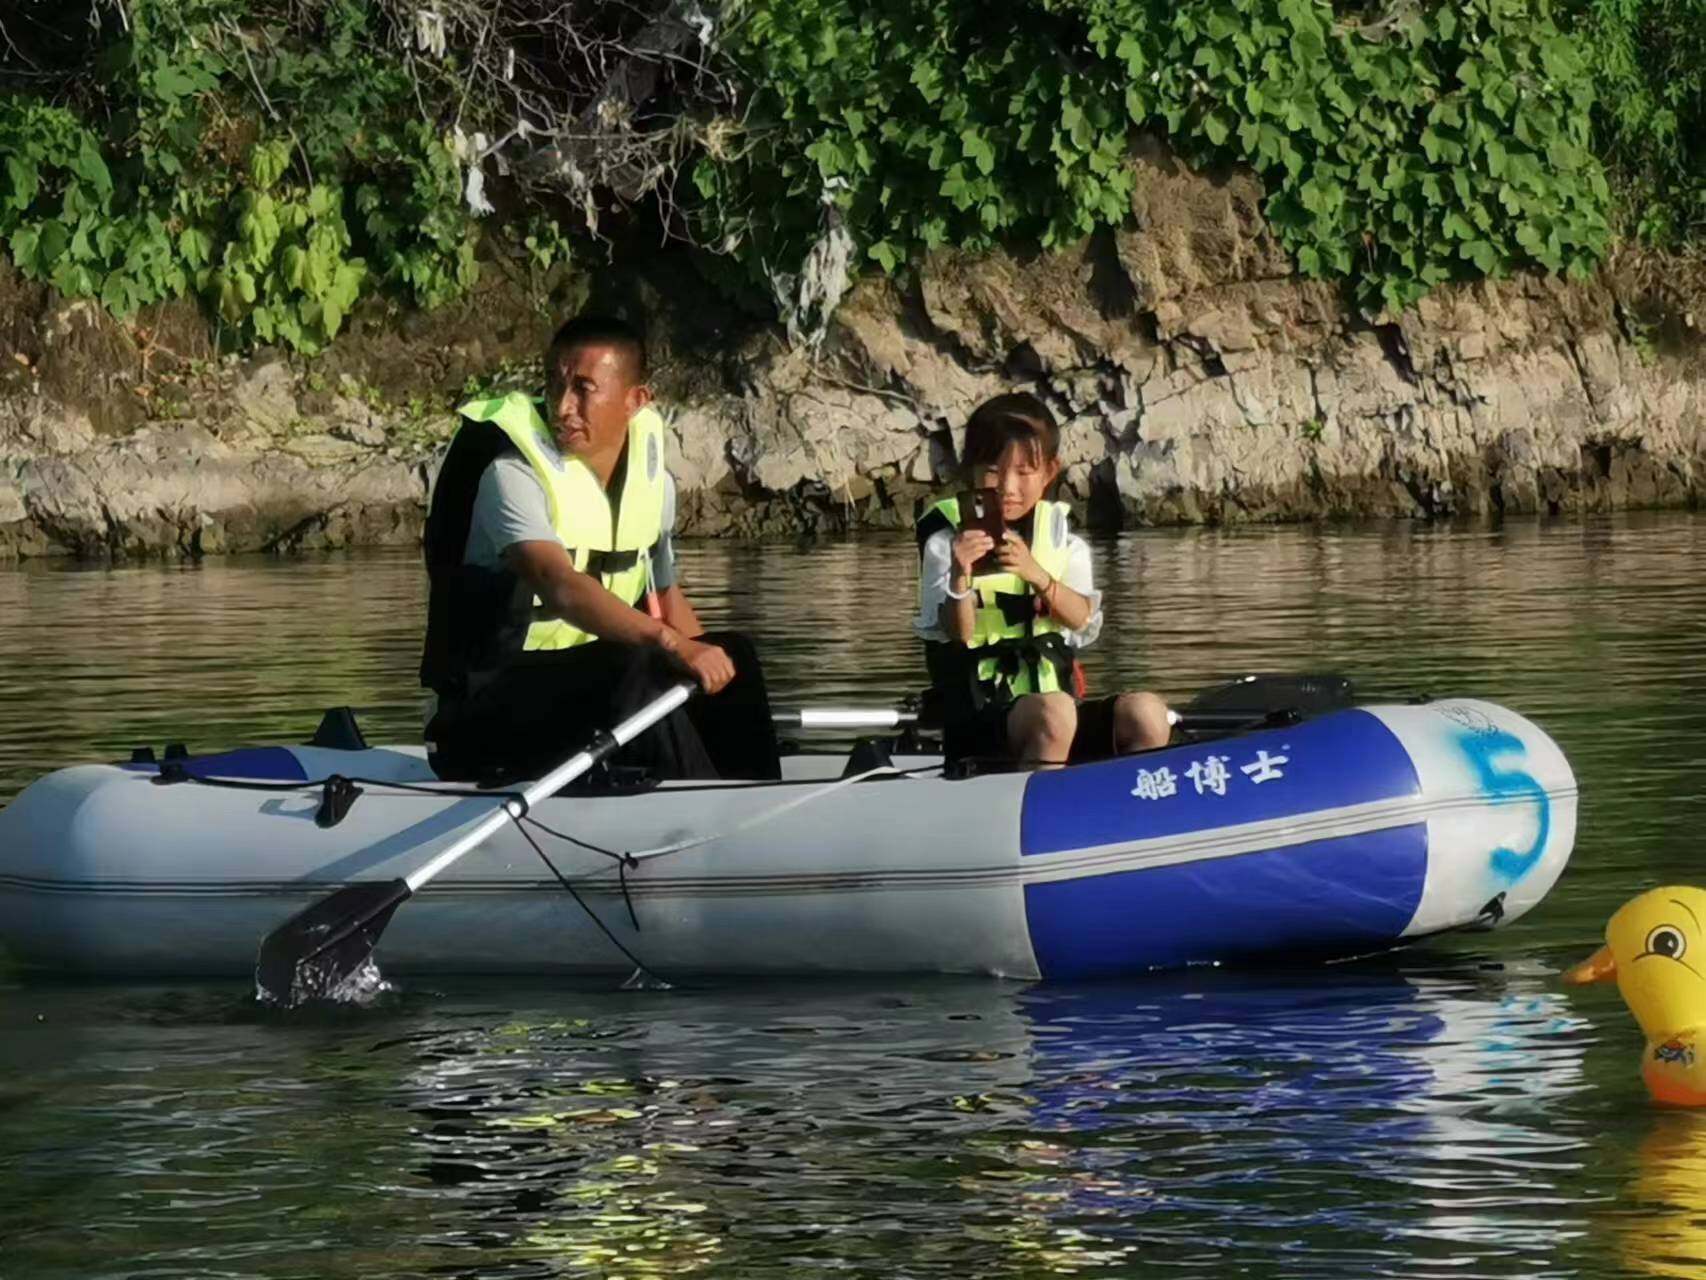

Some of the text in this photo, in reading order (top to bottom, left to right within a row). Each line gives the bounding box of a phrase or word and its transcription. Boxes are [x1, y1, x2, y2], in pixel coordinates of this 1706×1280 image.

[1131, 750, 1289, 800] 船博士
[1457, 731, 1551, 883] 5
